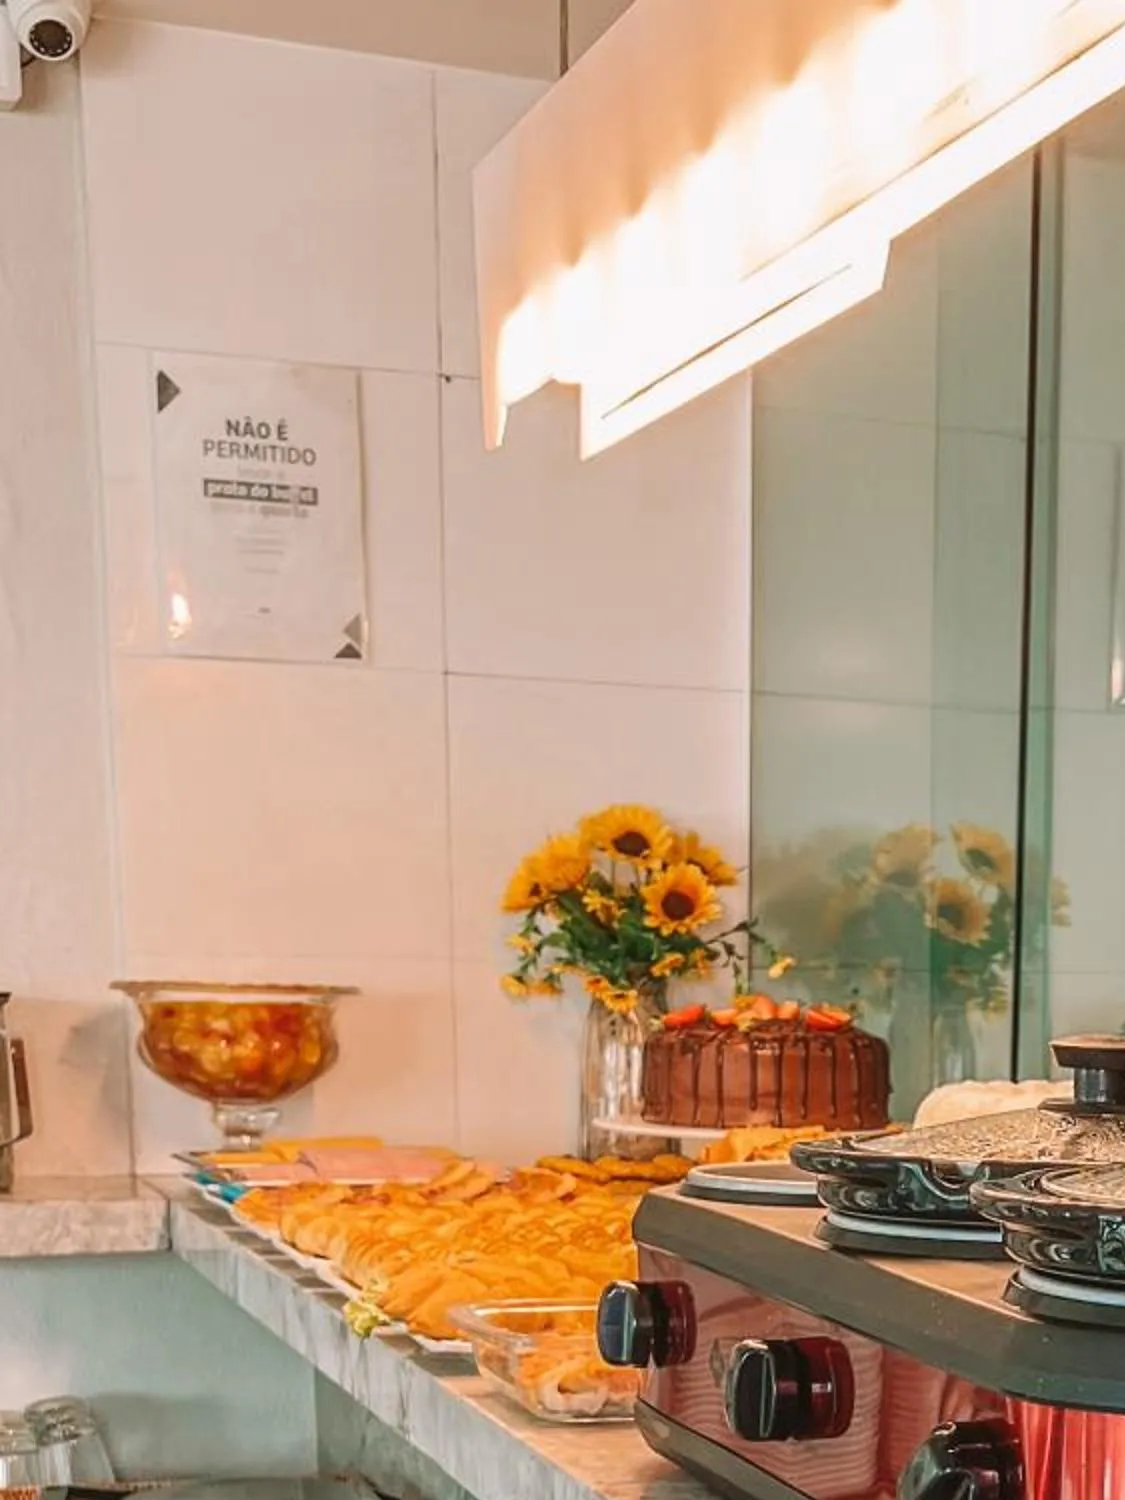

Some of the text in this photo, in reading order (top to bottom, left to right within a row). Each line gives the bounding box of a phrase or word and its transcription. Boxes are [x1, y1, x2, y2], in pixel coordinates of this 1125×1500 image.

[226, 415, 289, 441] NÃO É
[202, 438, 317, 466] PERMITIDO
